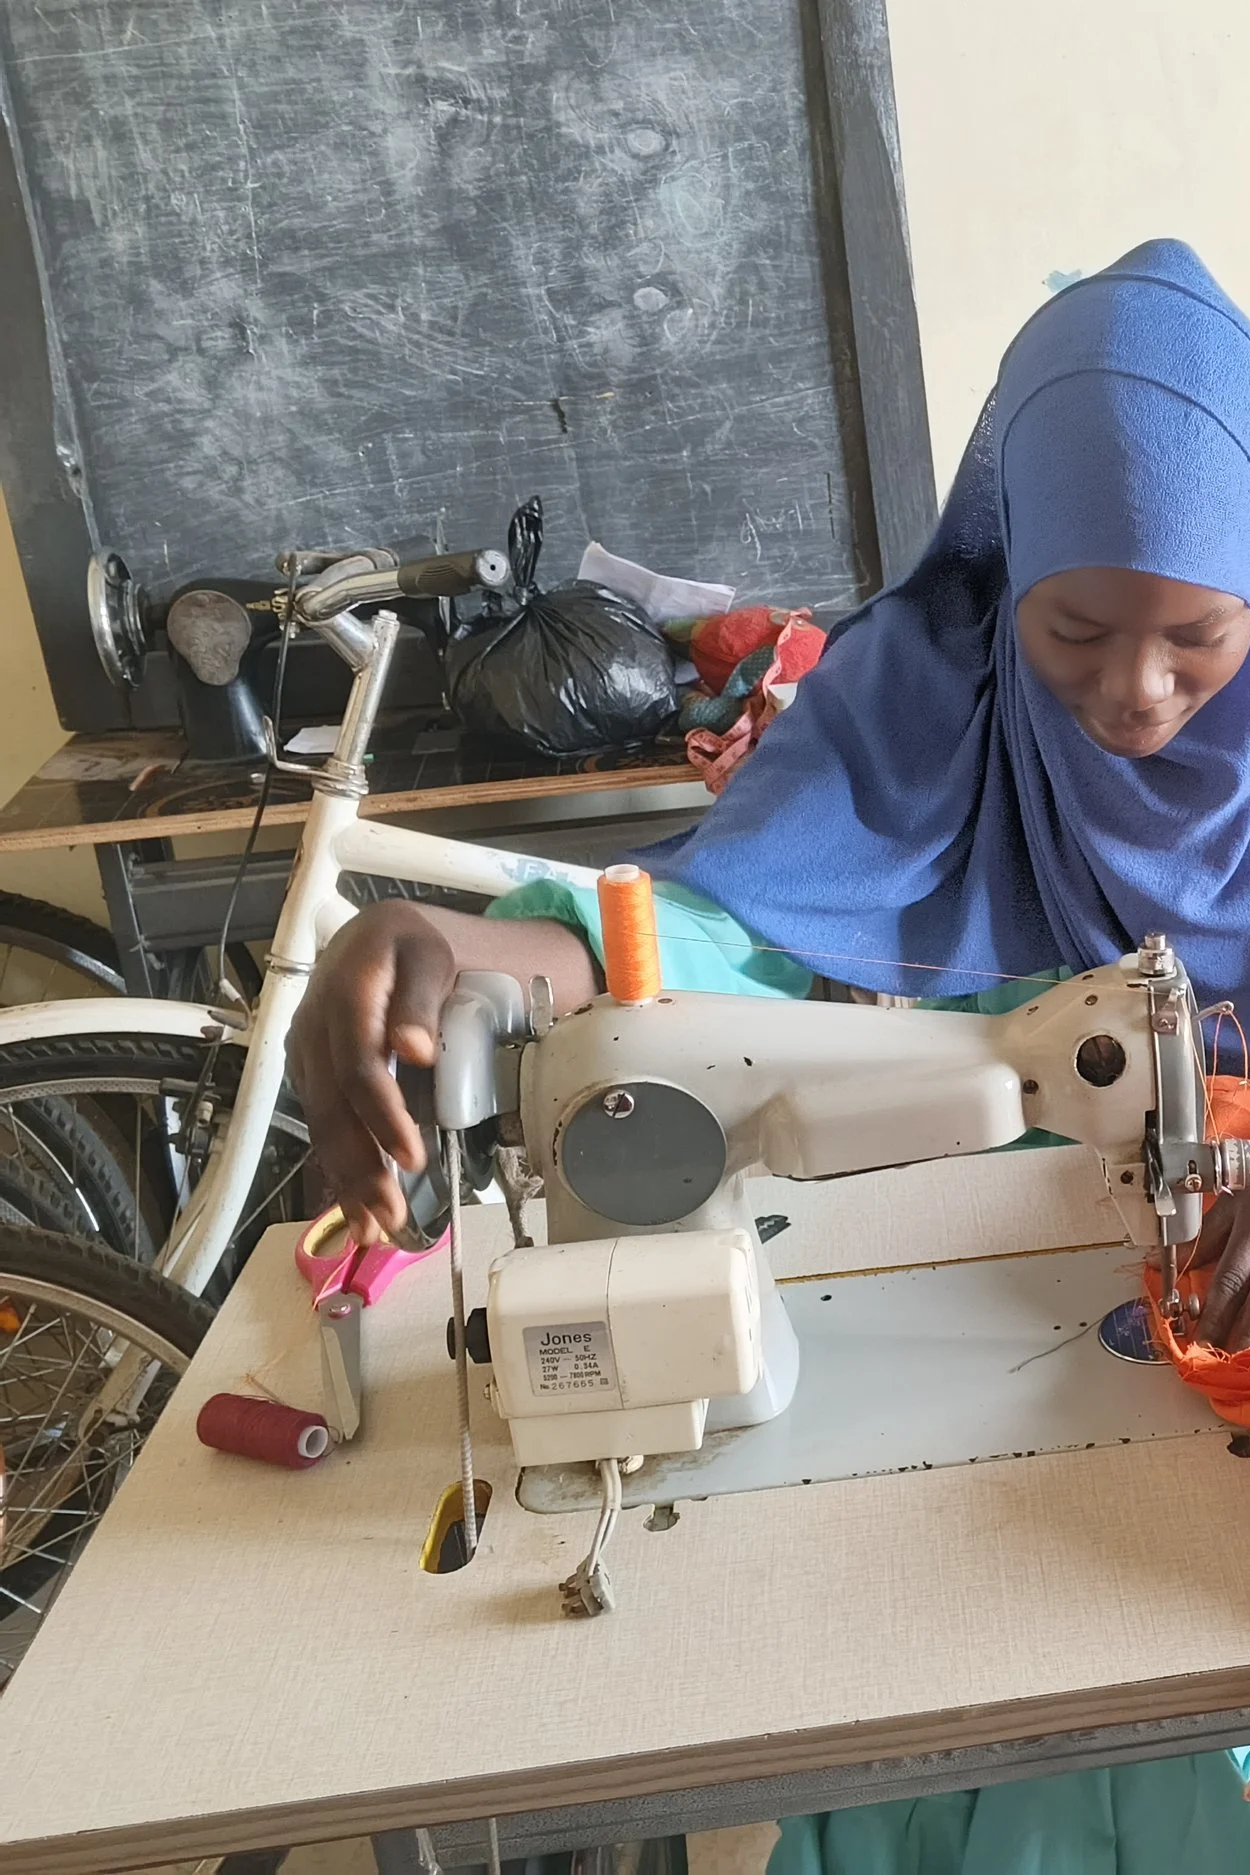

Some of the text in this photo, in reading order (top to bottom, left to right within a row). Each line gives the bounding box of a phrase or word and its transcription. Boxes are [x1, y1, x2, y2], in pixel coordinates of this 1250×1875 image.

[540, 1332, 592, 1346] Jones
[539, 1347, 573, 1356] MODEL
[540, 1356, 561, 1365] 240V
[575, 1353, 597, 1362] 50HZ
[542, 1365, 559, 1373] 27W
